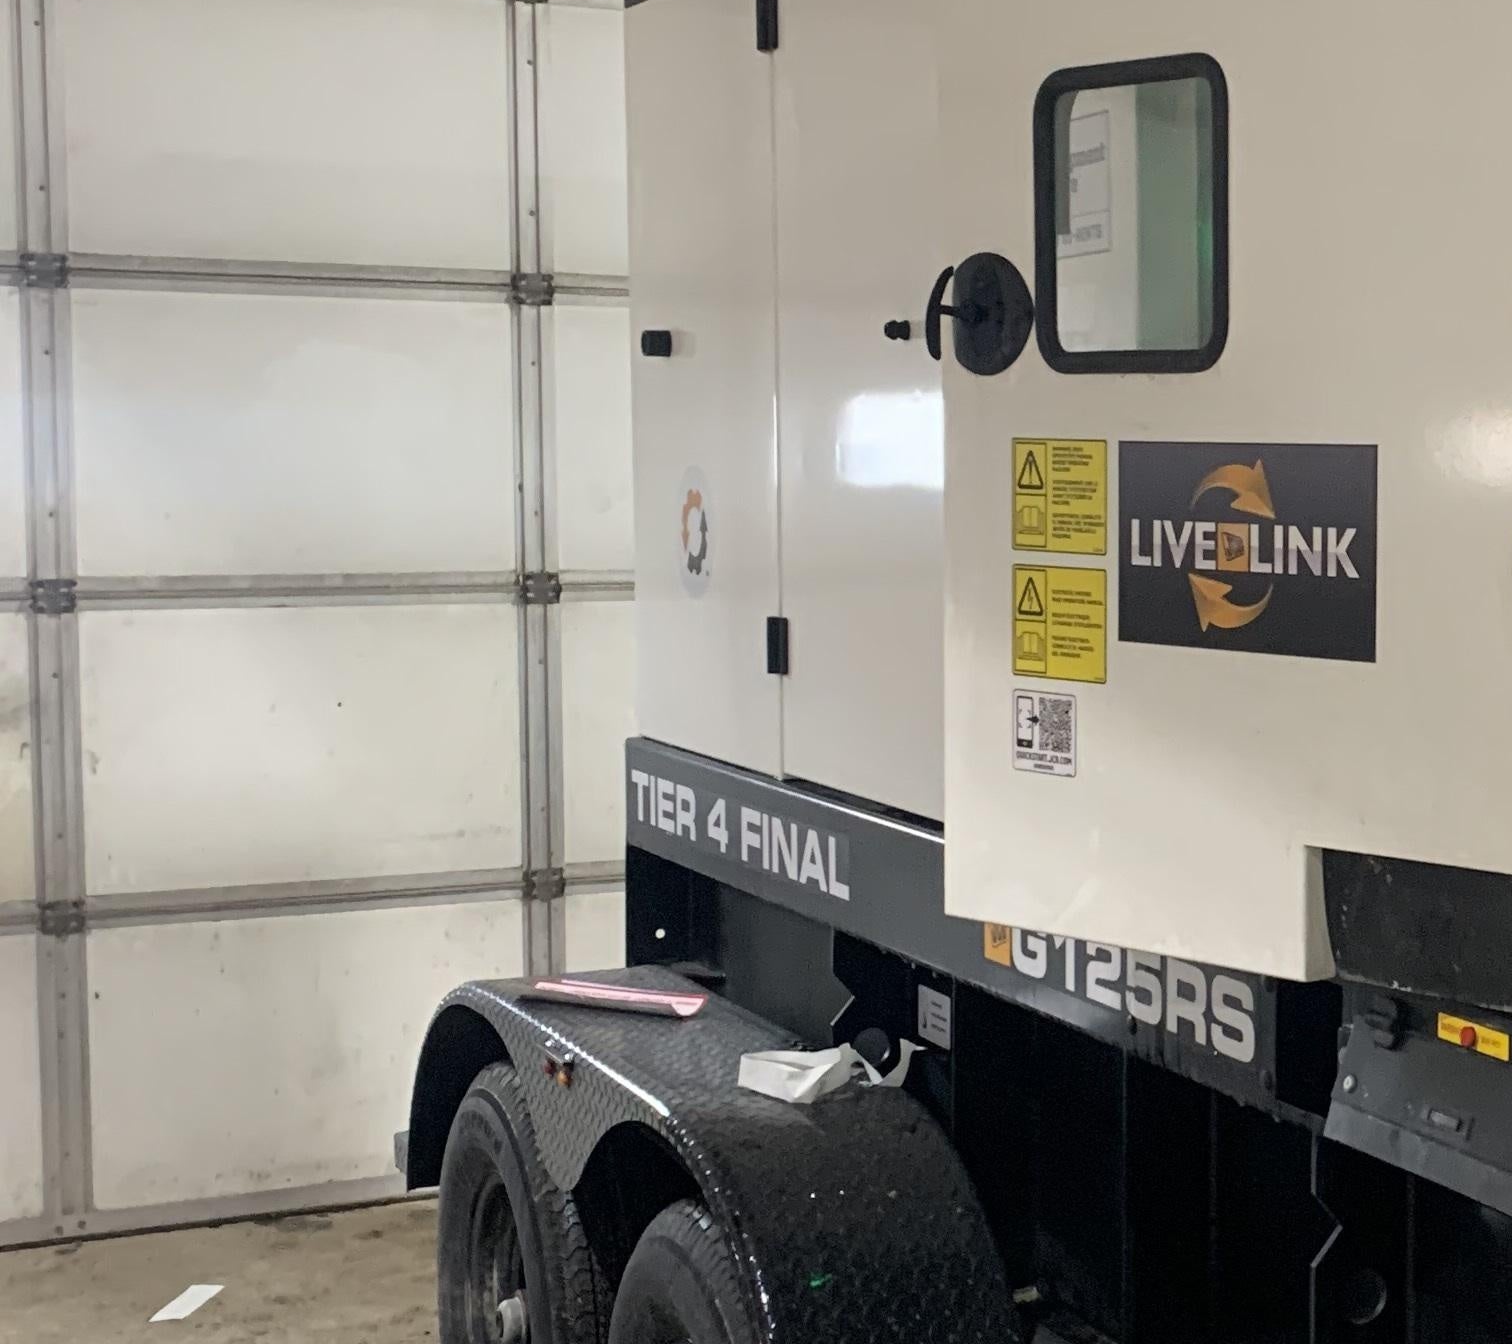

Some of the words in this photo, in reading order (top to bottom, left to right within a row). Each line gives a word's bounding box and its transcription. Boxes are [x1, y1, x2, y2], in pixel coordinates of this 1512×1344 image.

[1130, 518, 1217, 571] LIVE
[1249, 523, 1360, 579] LINK
[631, 769, 697, 842] TIER
[707, 798, 729, 854] 4
[740, 806, 850, 902] FINAL
